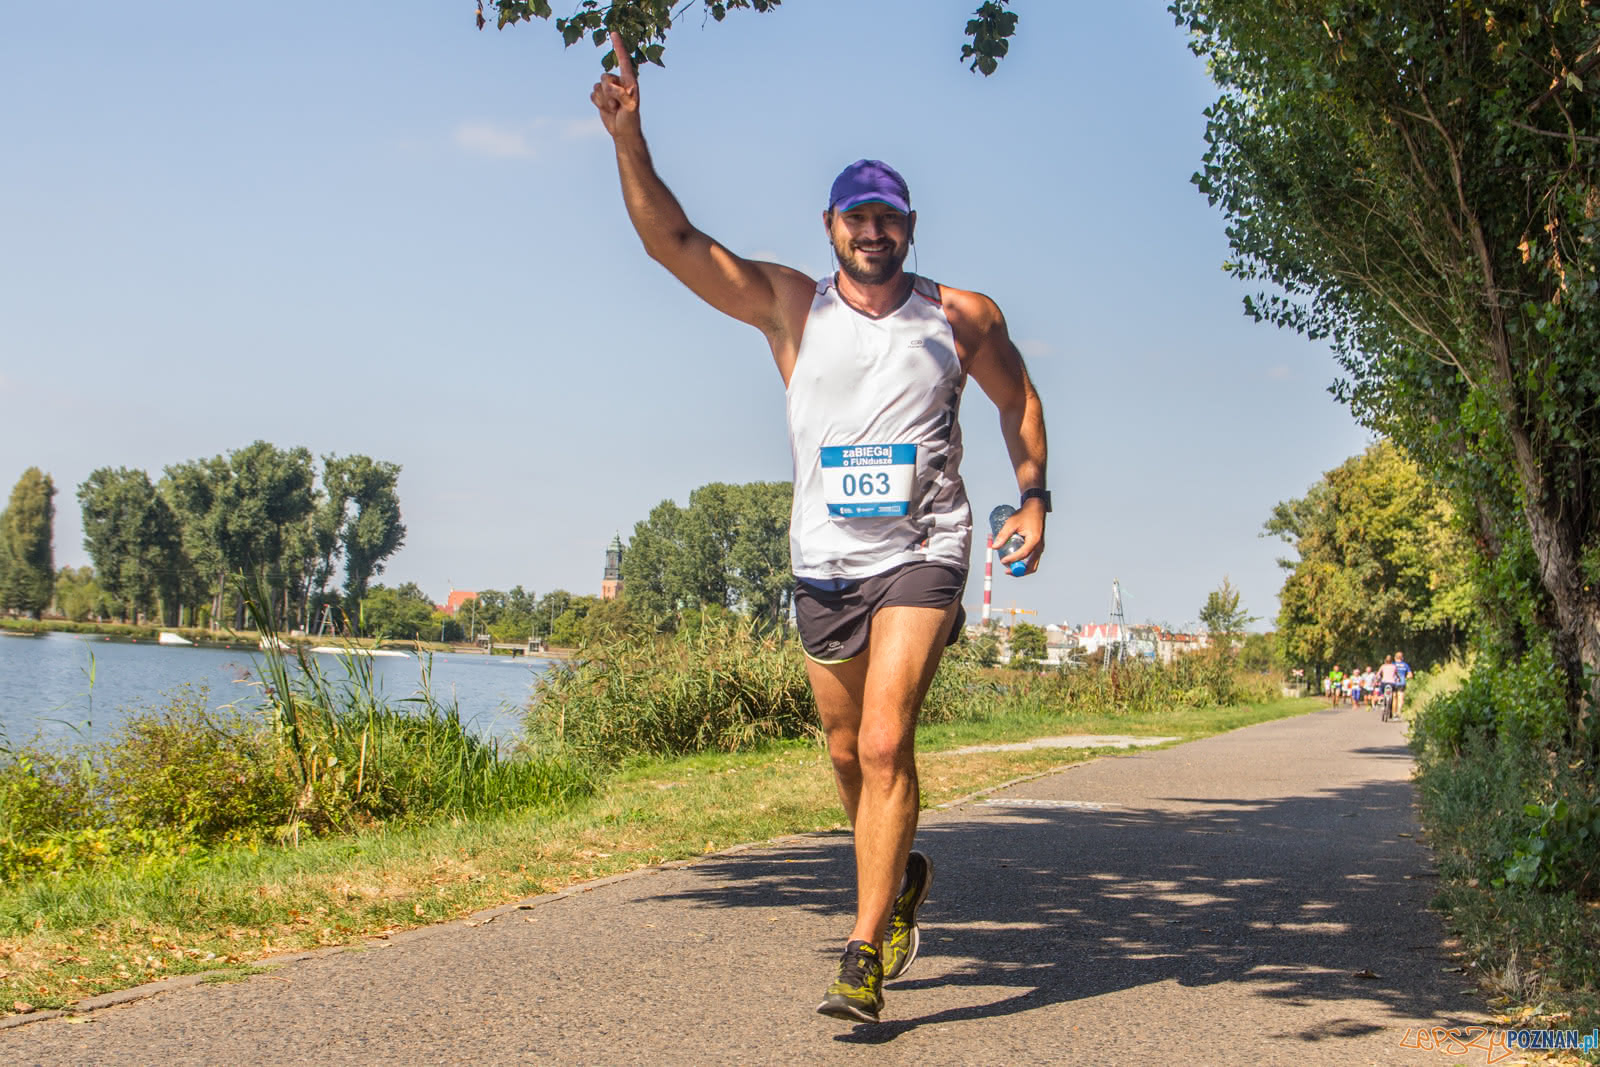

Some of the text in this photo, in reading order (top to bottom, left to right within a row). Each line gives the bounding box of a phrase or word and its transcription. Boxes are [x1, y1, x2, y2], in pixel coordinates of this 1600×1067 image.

[842, 445, 893, 458] zaBIEGaj
[850, 457, 893, 466] FUNdusze
[842, 472, 890, 496] 063
